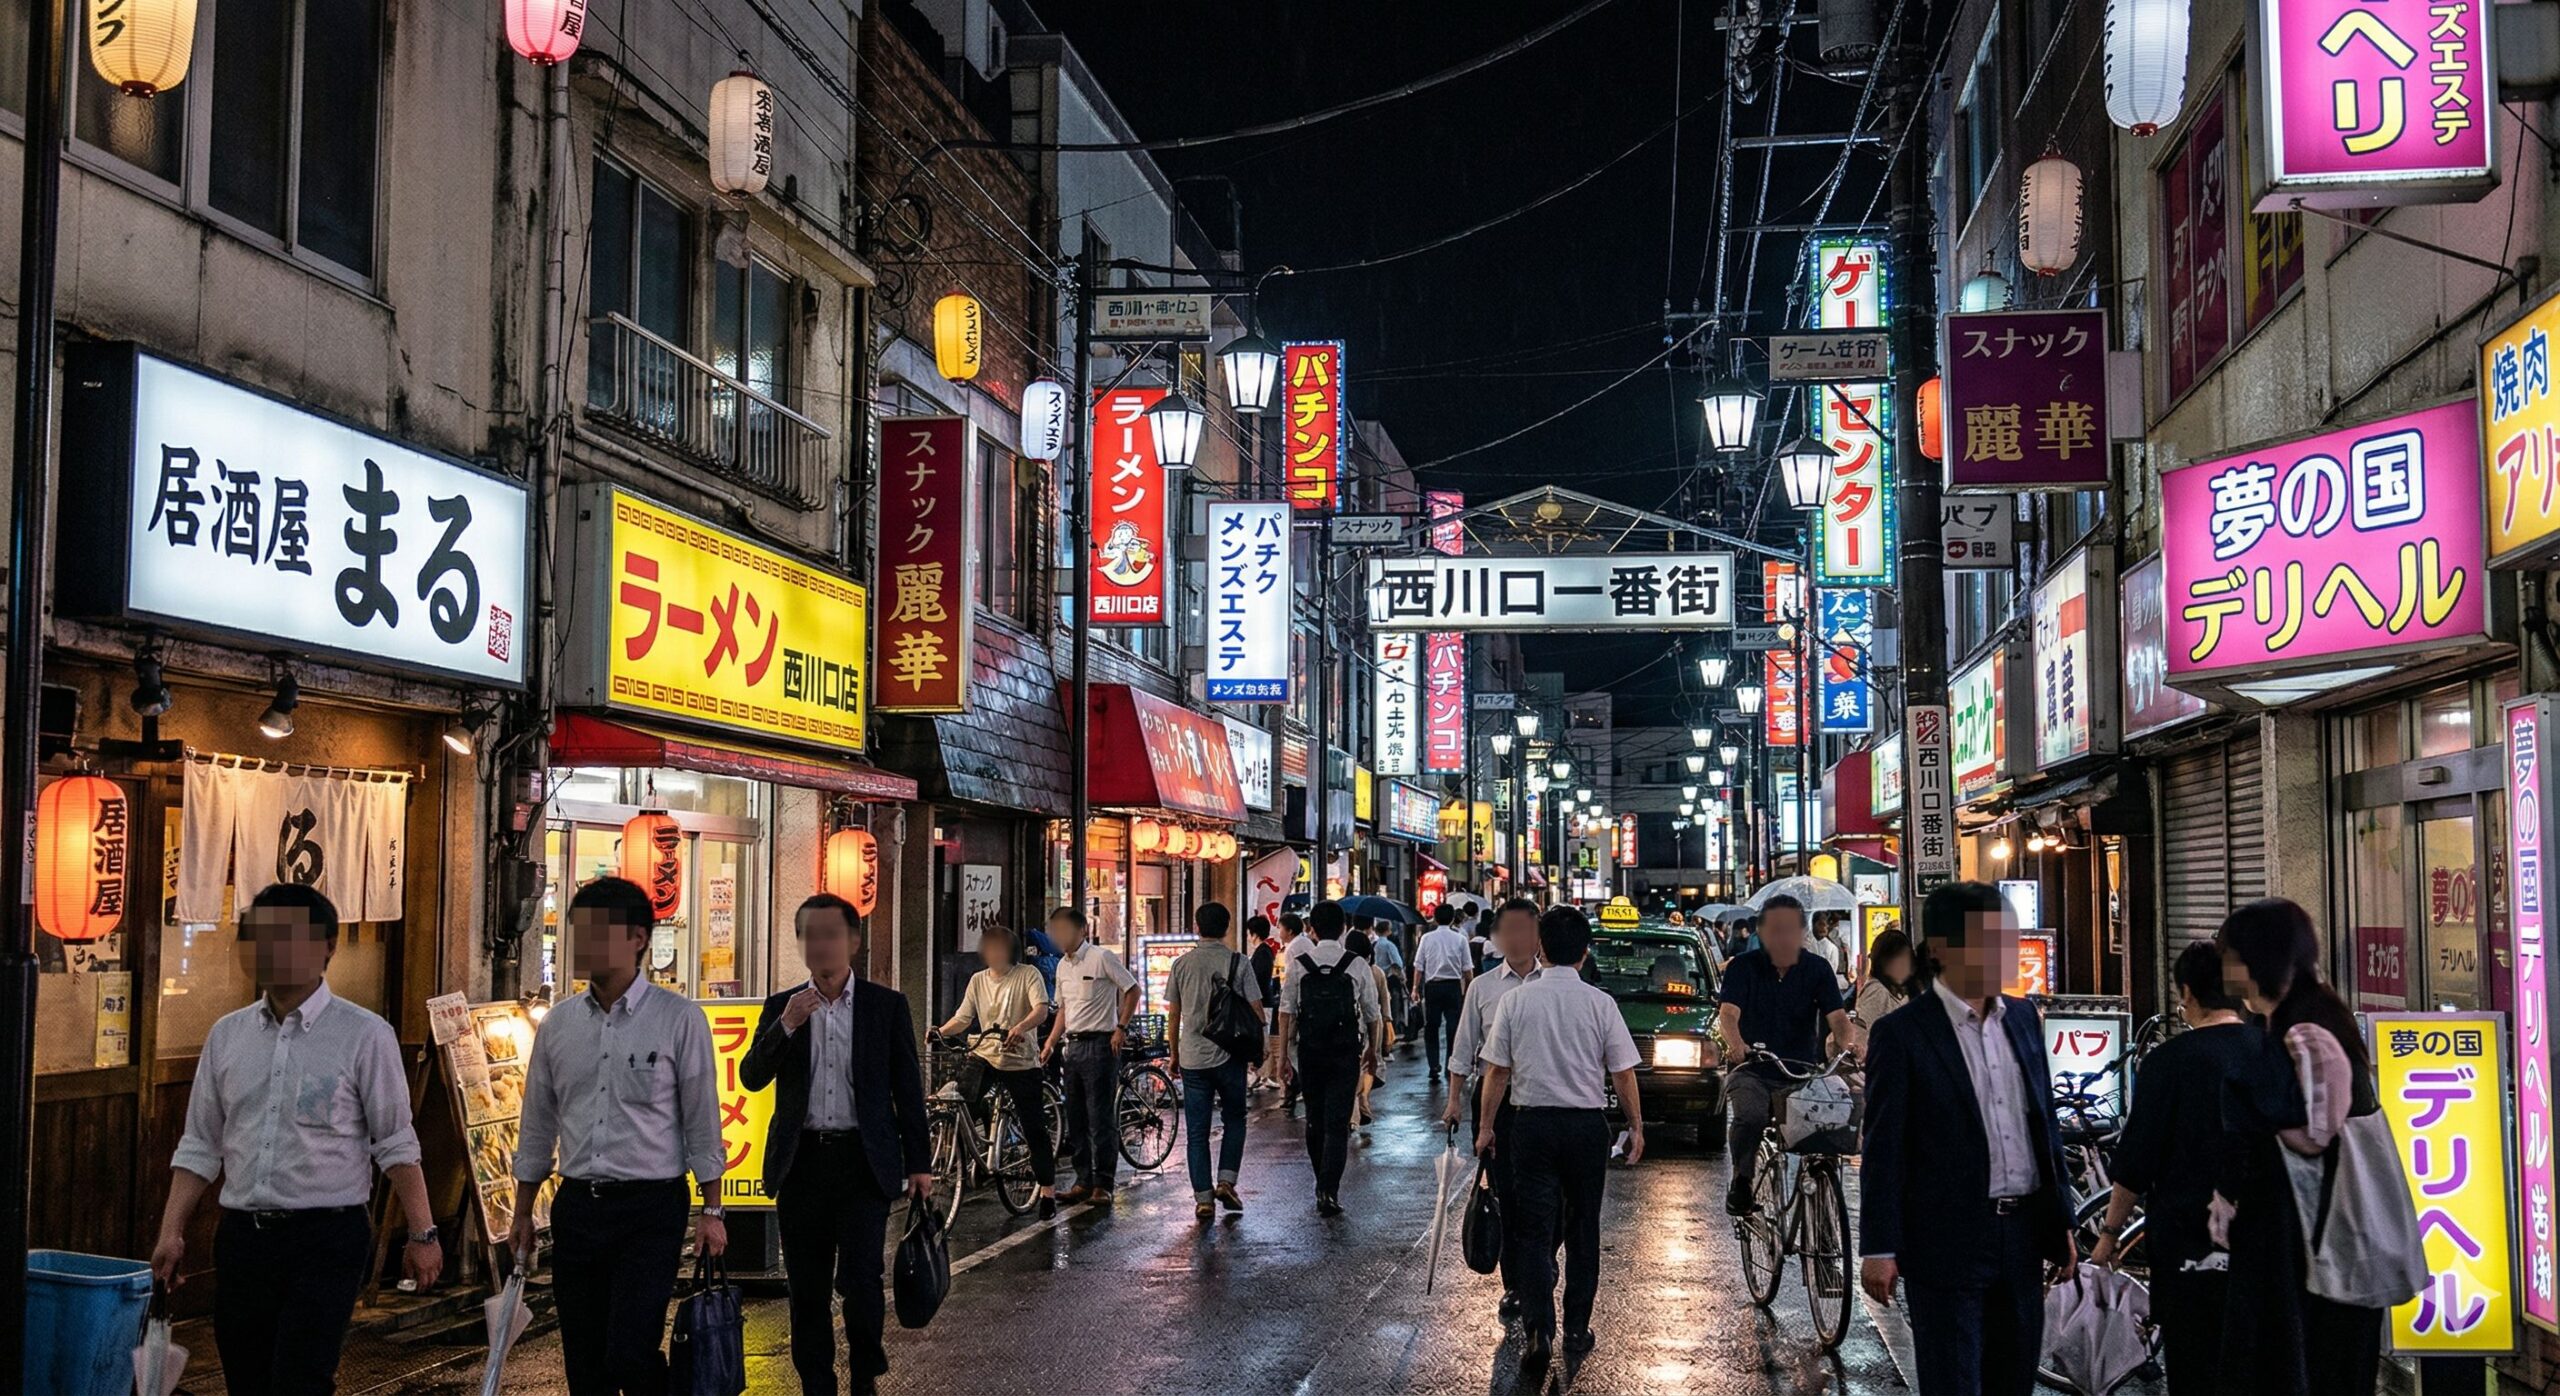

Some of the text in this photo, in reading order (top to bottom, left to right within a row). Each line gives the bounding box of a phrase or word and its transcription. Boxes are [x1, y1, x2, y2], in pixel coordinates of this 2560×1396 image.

[1962, 326, 2088, 358] スナック
[2493, 328, 2548, 422] 焼肉
[1111, 396, 1147, 514] ラーメン
[1292, 351, 1331, 500] パチンコ
[1963, 401, 2096, 462] 麗華
[2497, 427, 2560, 524] アリ
[148, 442, 480, 645] 居酒屋 まる
[905, 430, 937, 555] スナック
[1338, 519, 1394, 534] スナック
[2210, 429, 2425, 560] 夢の国
[620, 552, 779, 688] ラーメン
[783, 648, 859, 715] 西川口店
[888, 563, 949, 693] 麗華
[1094, 595, 1158, 615] 西川口店
[1218, 511, 1247, 673] メンズエステ
[1384, 564, 1720, 618] 西川口一番街
[2184, 538, 2465, 661] デリヘル
[90, 797, 128, 917] 居酒屋
[1918, 748, 1944, 857] 西川口番街
[2053, 1030, 2111, 1057] パブ
[2389, 1029, 2483, 1058] 夢の国
[2402, 1064, 2486, 1335] デリヘル
